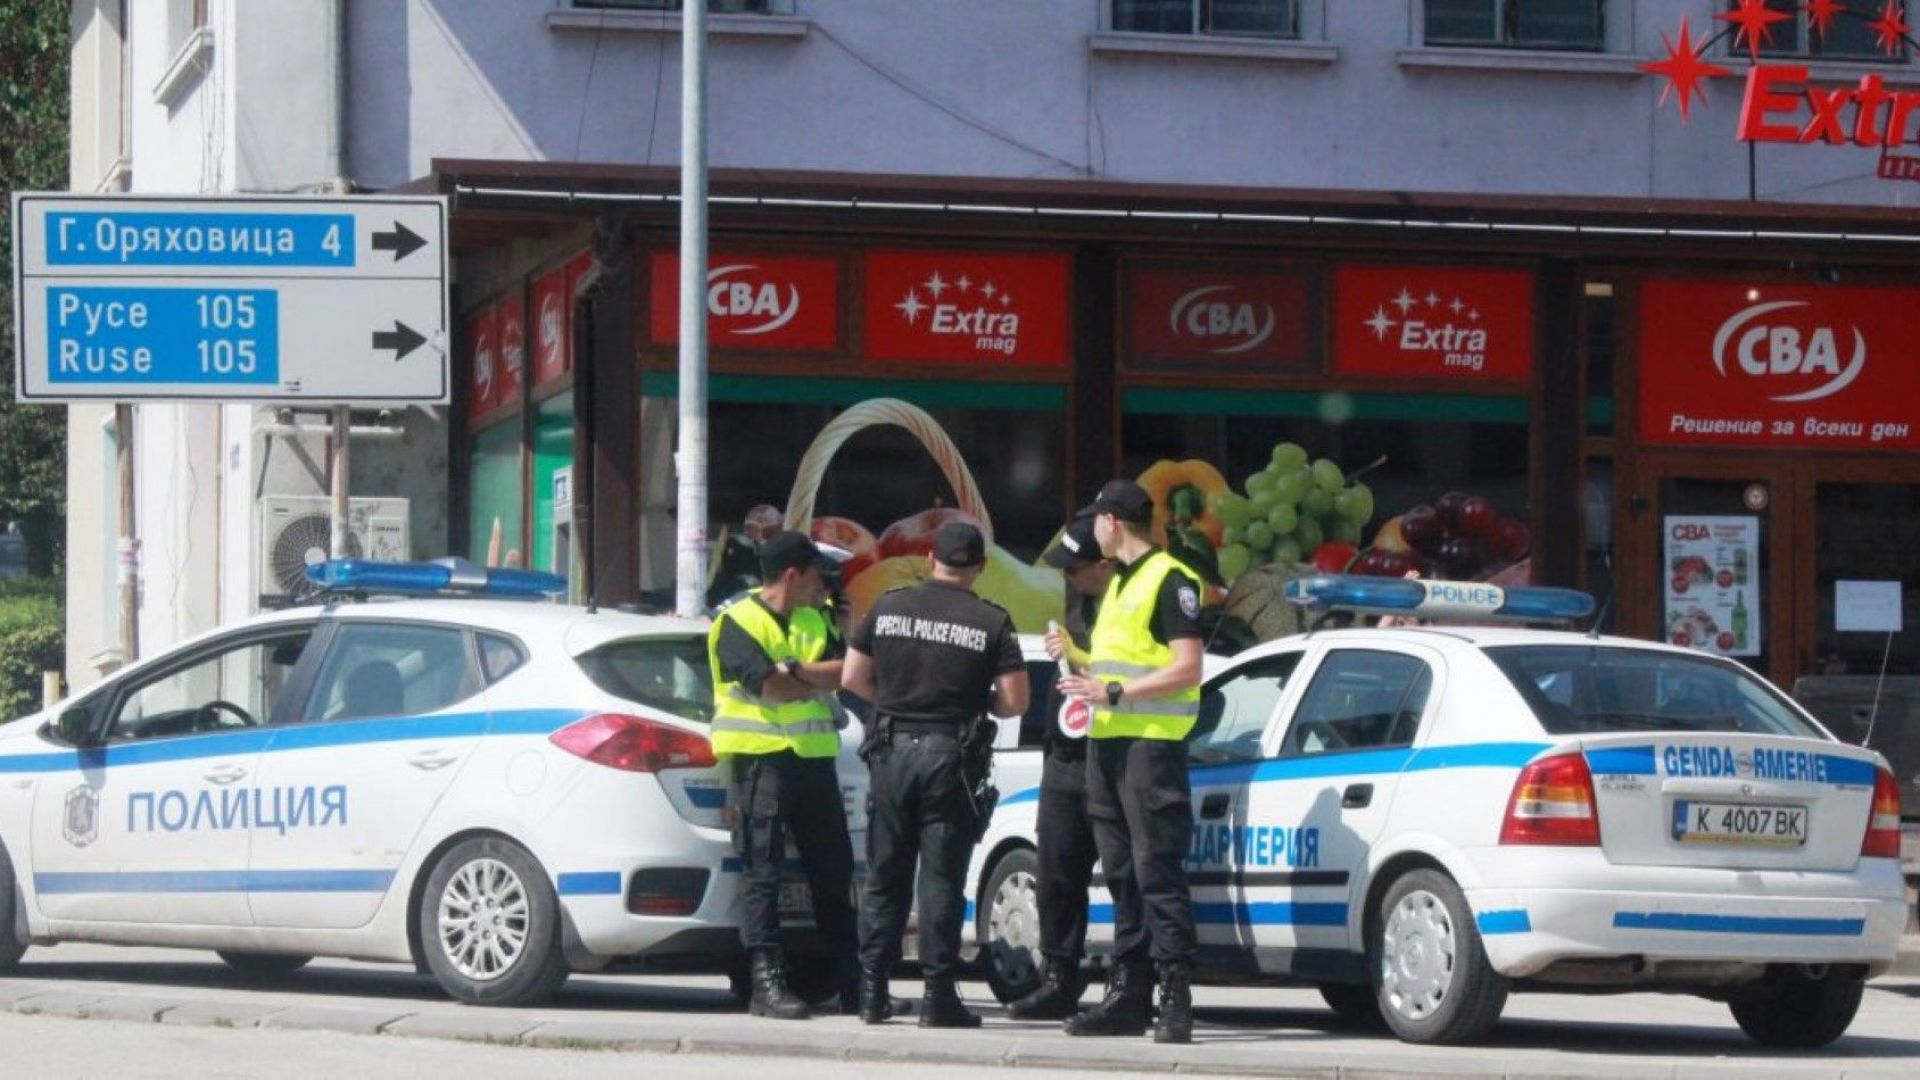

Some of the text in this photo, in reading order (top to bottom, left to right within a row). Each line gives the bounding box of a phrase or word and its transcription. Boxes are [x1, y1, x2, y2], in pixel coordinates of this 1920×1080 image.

[1735, 64, 1920, 148] Extr
[321, 224, 341, 257] 4
[59, 293, 256, 336] Русе 105
[708, 281, 780, 316] CBA
[931, 303, 1018, 336] Extra
[1187, 302, 1257, 335] CBA
[976, 335, 1016, 354] mag
[1400, 320, 1487, 351] Extra
[1737, 325, 1841, 376] CBA
[59, 339, 257, 374] Ruse 105
[1445, 350, 1484, 371] mag
[1670, 415, 1763, 435] Решение
[1770, 420, 1795, 436] за
[1870, 422, 1909, 442] ден
[1672, 524, 1711, 541] CBA
[1431, 585, 1499, 605] POLICE
[875, 615, 988, 652] SPECIAL POLICE FORCES
[1663, 745, 1827, 782] GENDA RMERIE
[127, 784, 347, 836] ПОЛИЦИЯ
[1697, 807, 1802, 835] K 4007 BK
